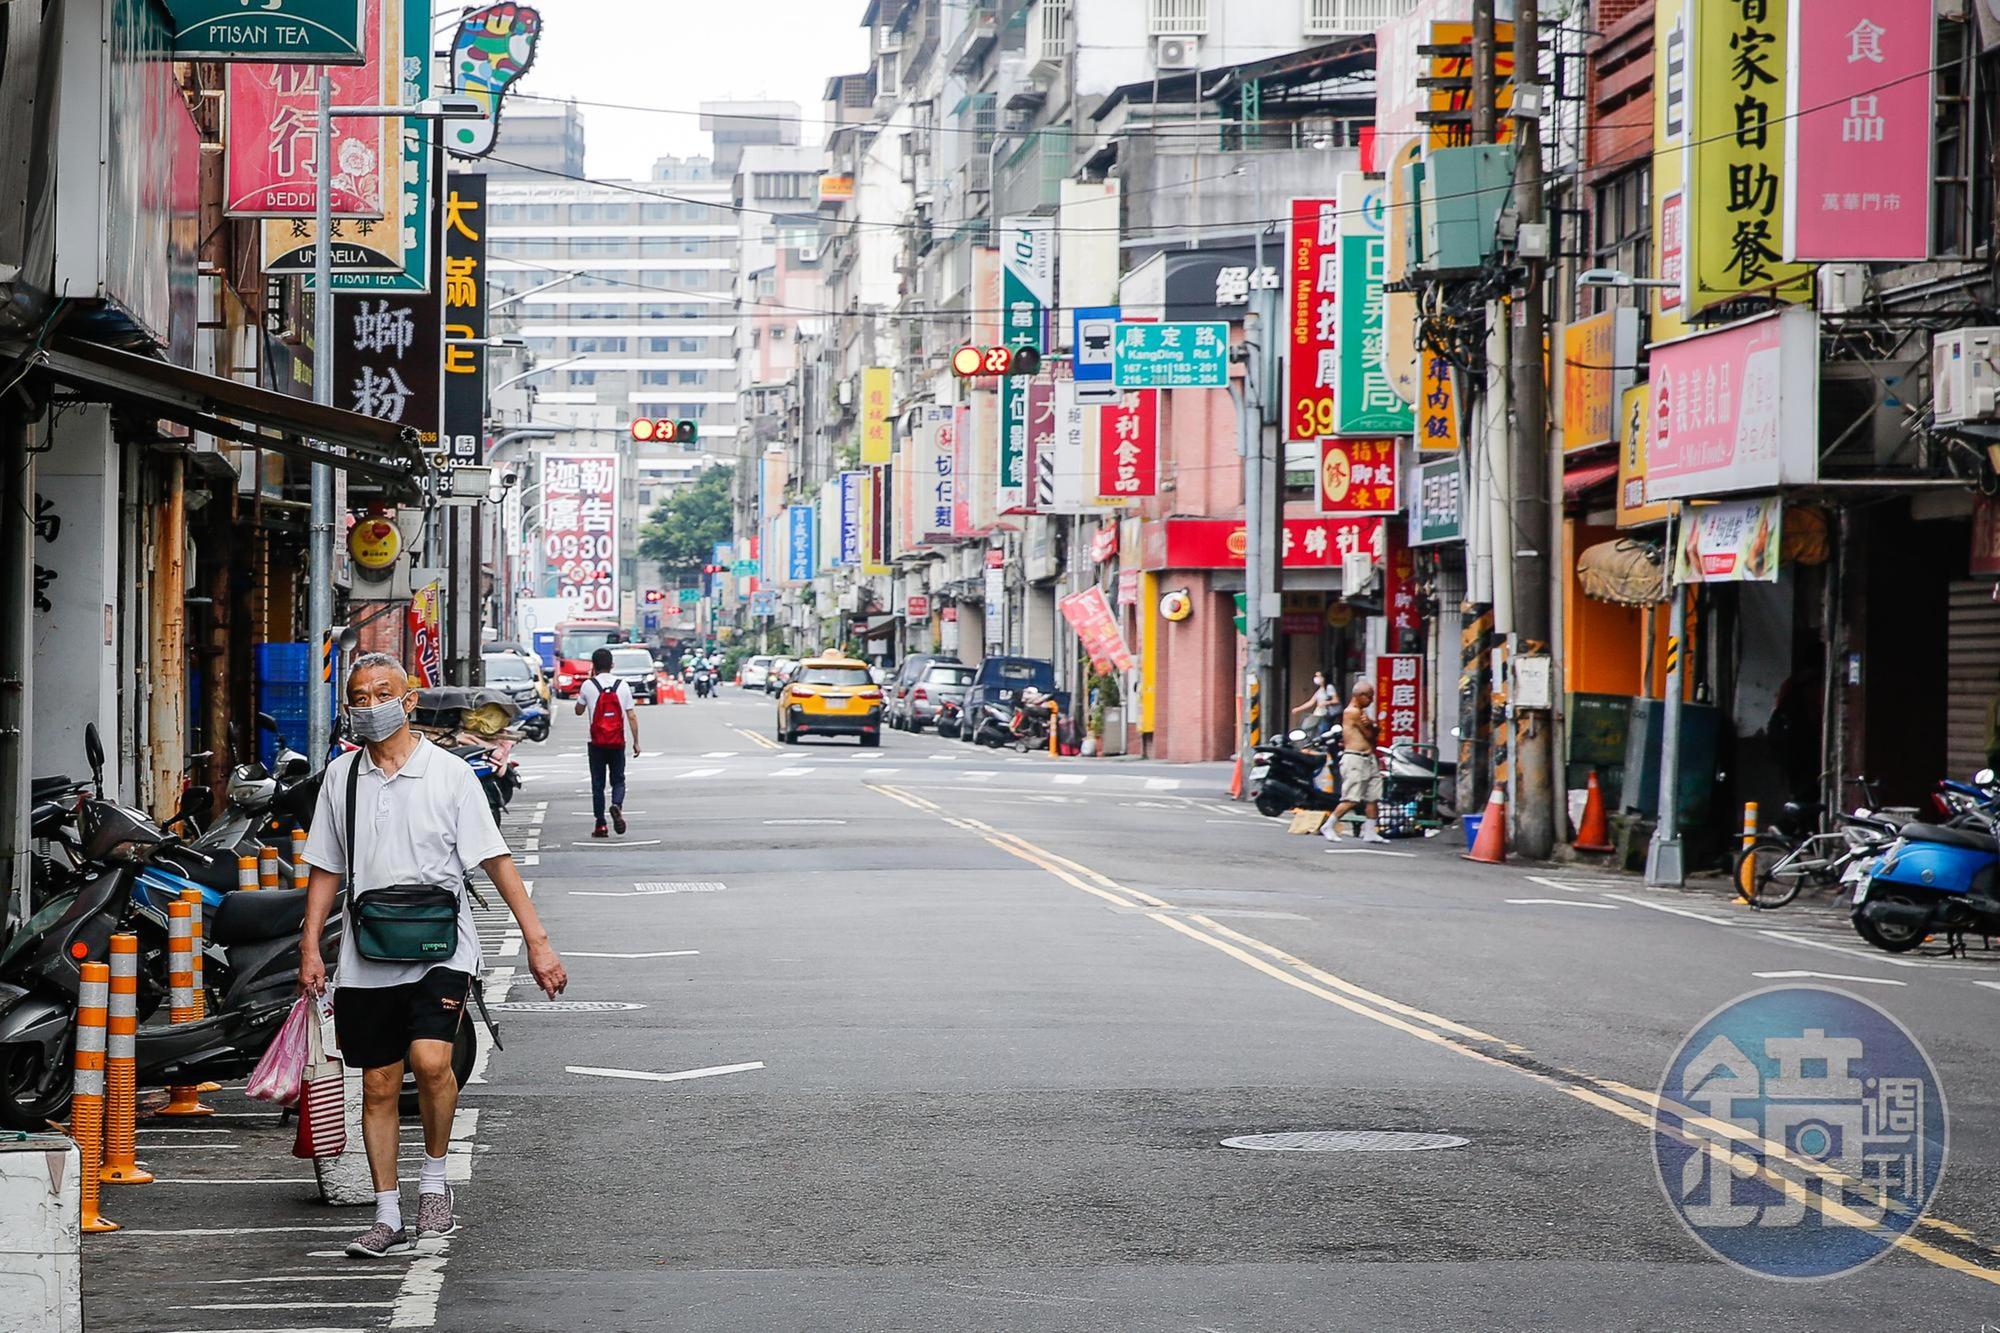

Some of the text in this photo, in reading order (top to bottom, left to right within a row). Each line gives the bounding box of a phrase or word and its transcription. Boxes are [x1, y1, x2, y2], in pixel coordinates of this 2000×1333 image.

[209, 26, 309, 44] PTISAN TEA
[1842, 18, 1887, 142] 食品
[266, 192, 341, 206] BEDDIG
[1822, 192, 1901, 211] 萬華門市
[1295, 238, 1312, 345] Foot Massage
[1720, 302, 1748, 314] FAST
[1125, 326, 1216, 347] 康定路
[985, 350, 1006, 371] 22
[1677, 362, 1731, 432] 義美食品
[656, 421, 674, 439] 23
[1351, 441, 1391, 461] 指甲
[1351, 463, 1393, 485] 腳皮
[547, 534, 613, 560] 0930
